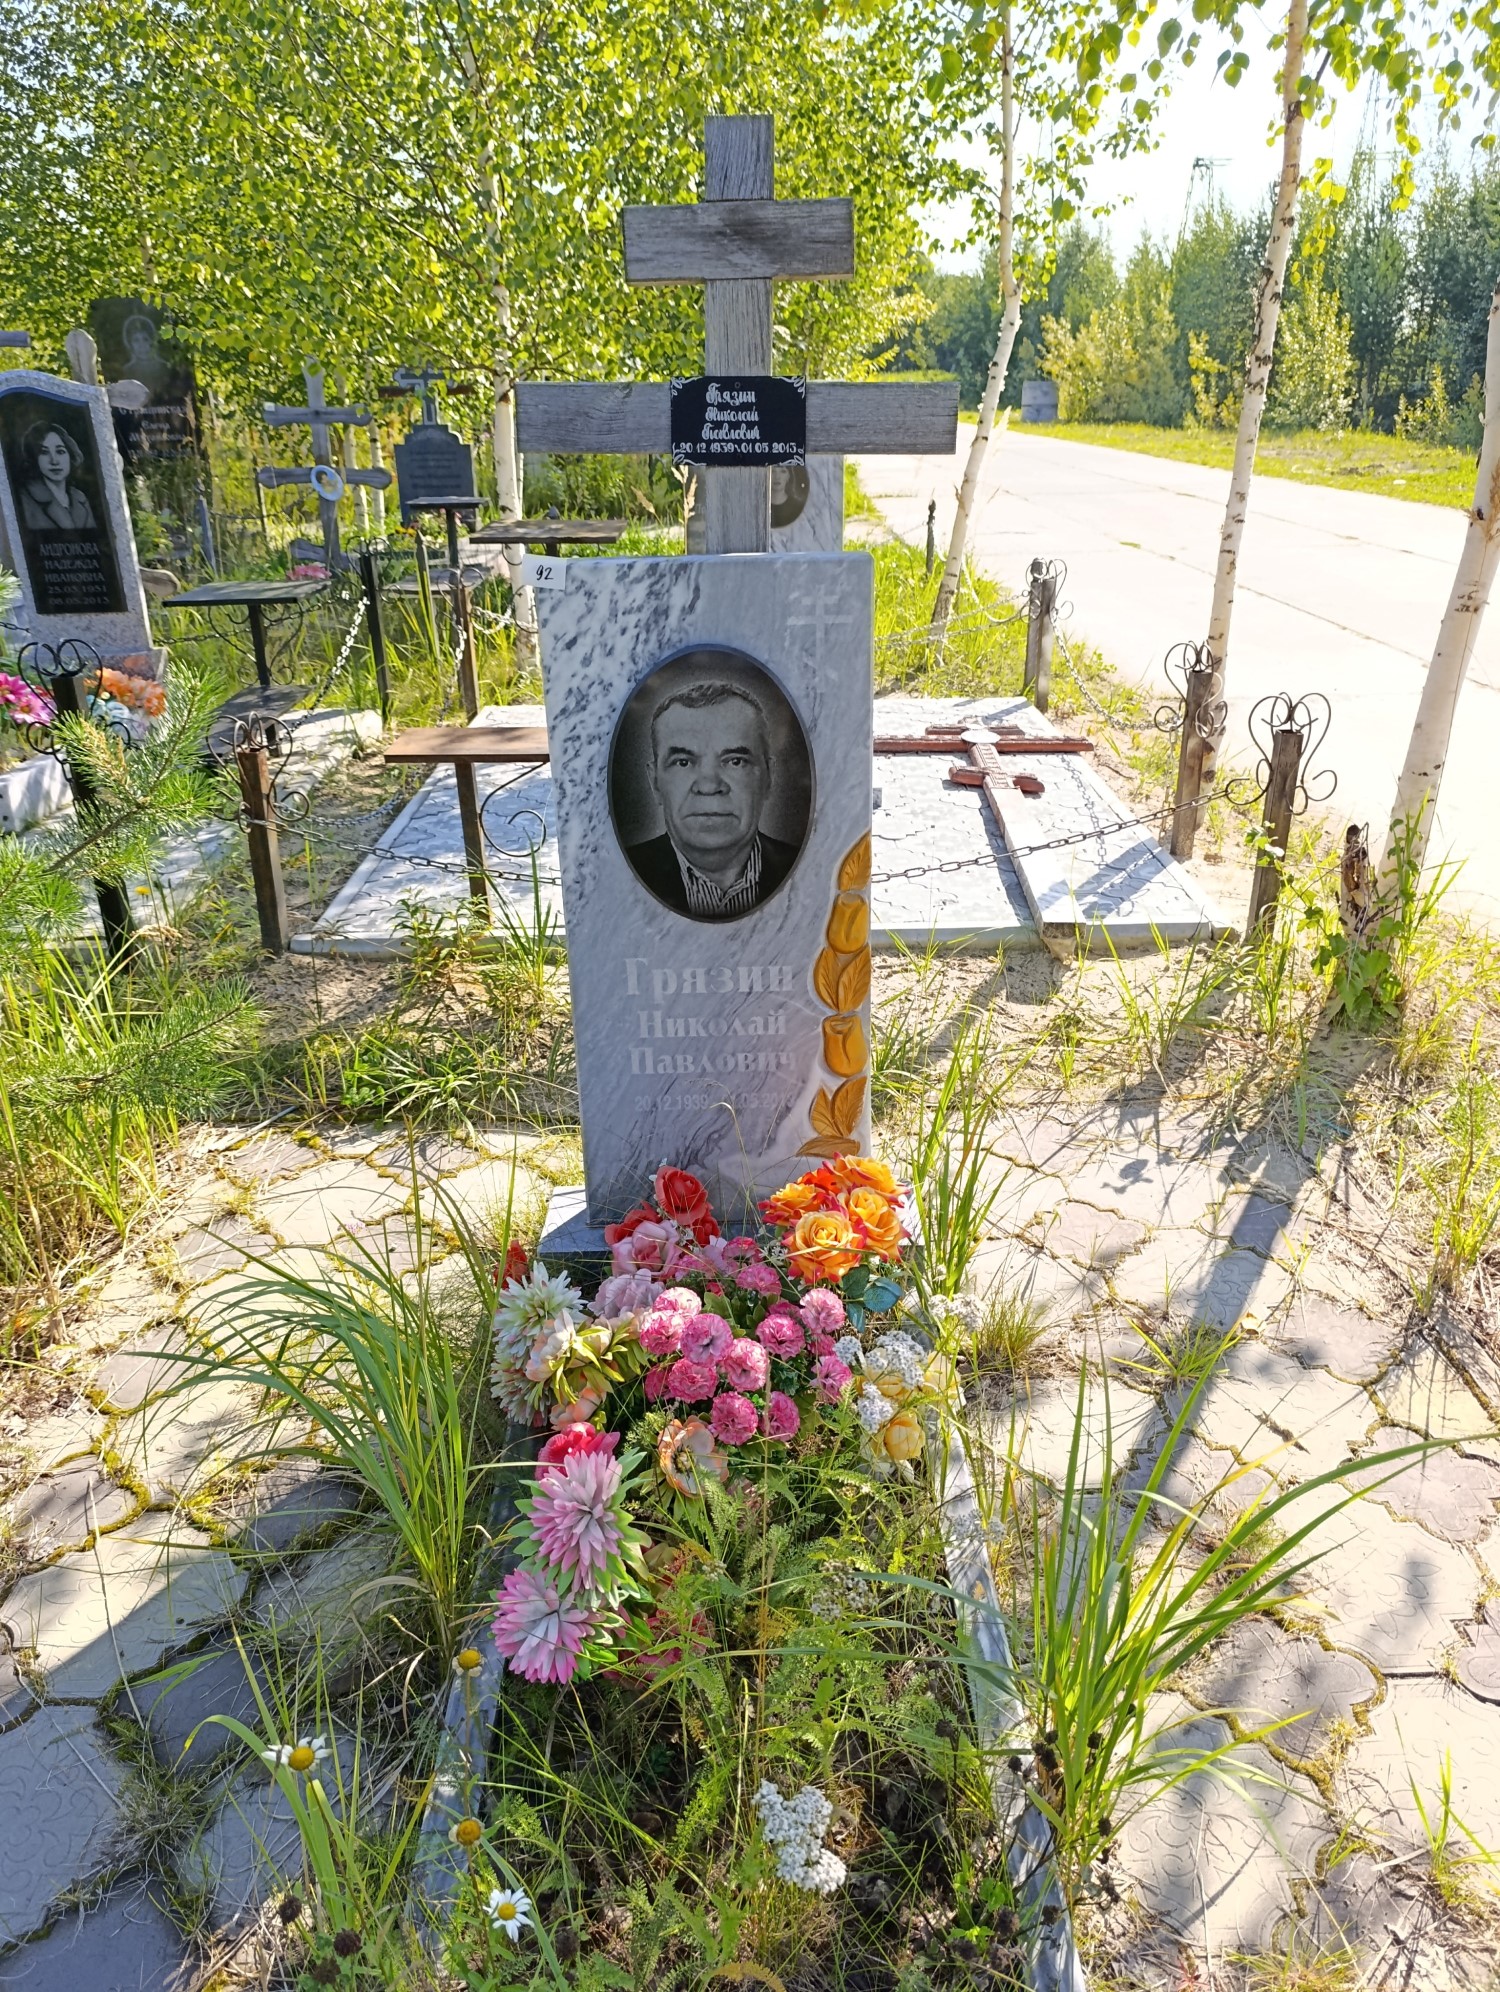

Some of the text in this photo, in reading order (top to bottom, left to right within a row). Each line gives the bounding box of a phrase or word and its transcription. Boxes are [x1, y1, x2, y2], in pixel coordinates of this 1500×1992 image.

[706, 382, 756, 406] Грязин
[705, 406, 759, 421] Николай
[702, 423, 760, 440] Павлович
[536, 564, 554, 581] 92
[624, 957, 795, 1005] Грязин
[637, 1008, 787, 1039] Николай
[629, 1047, 797, 1075] Павлович
